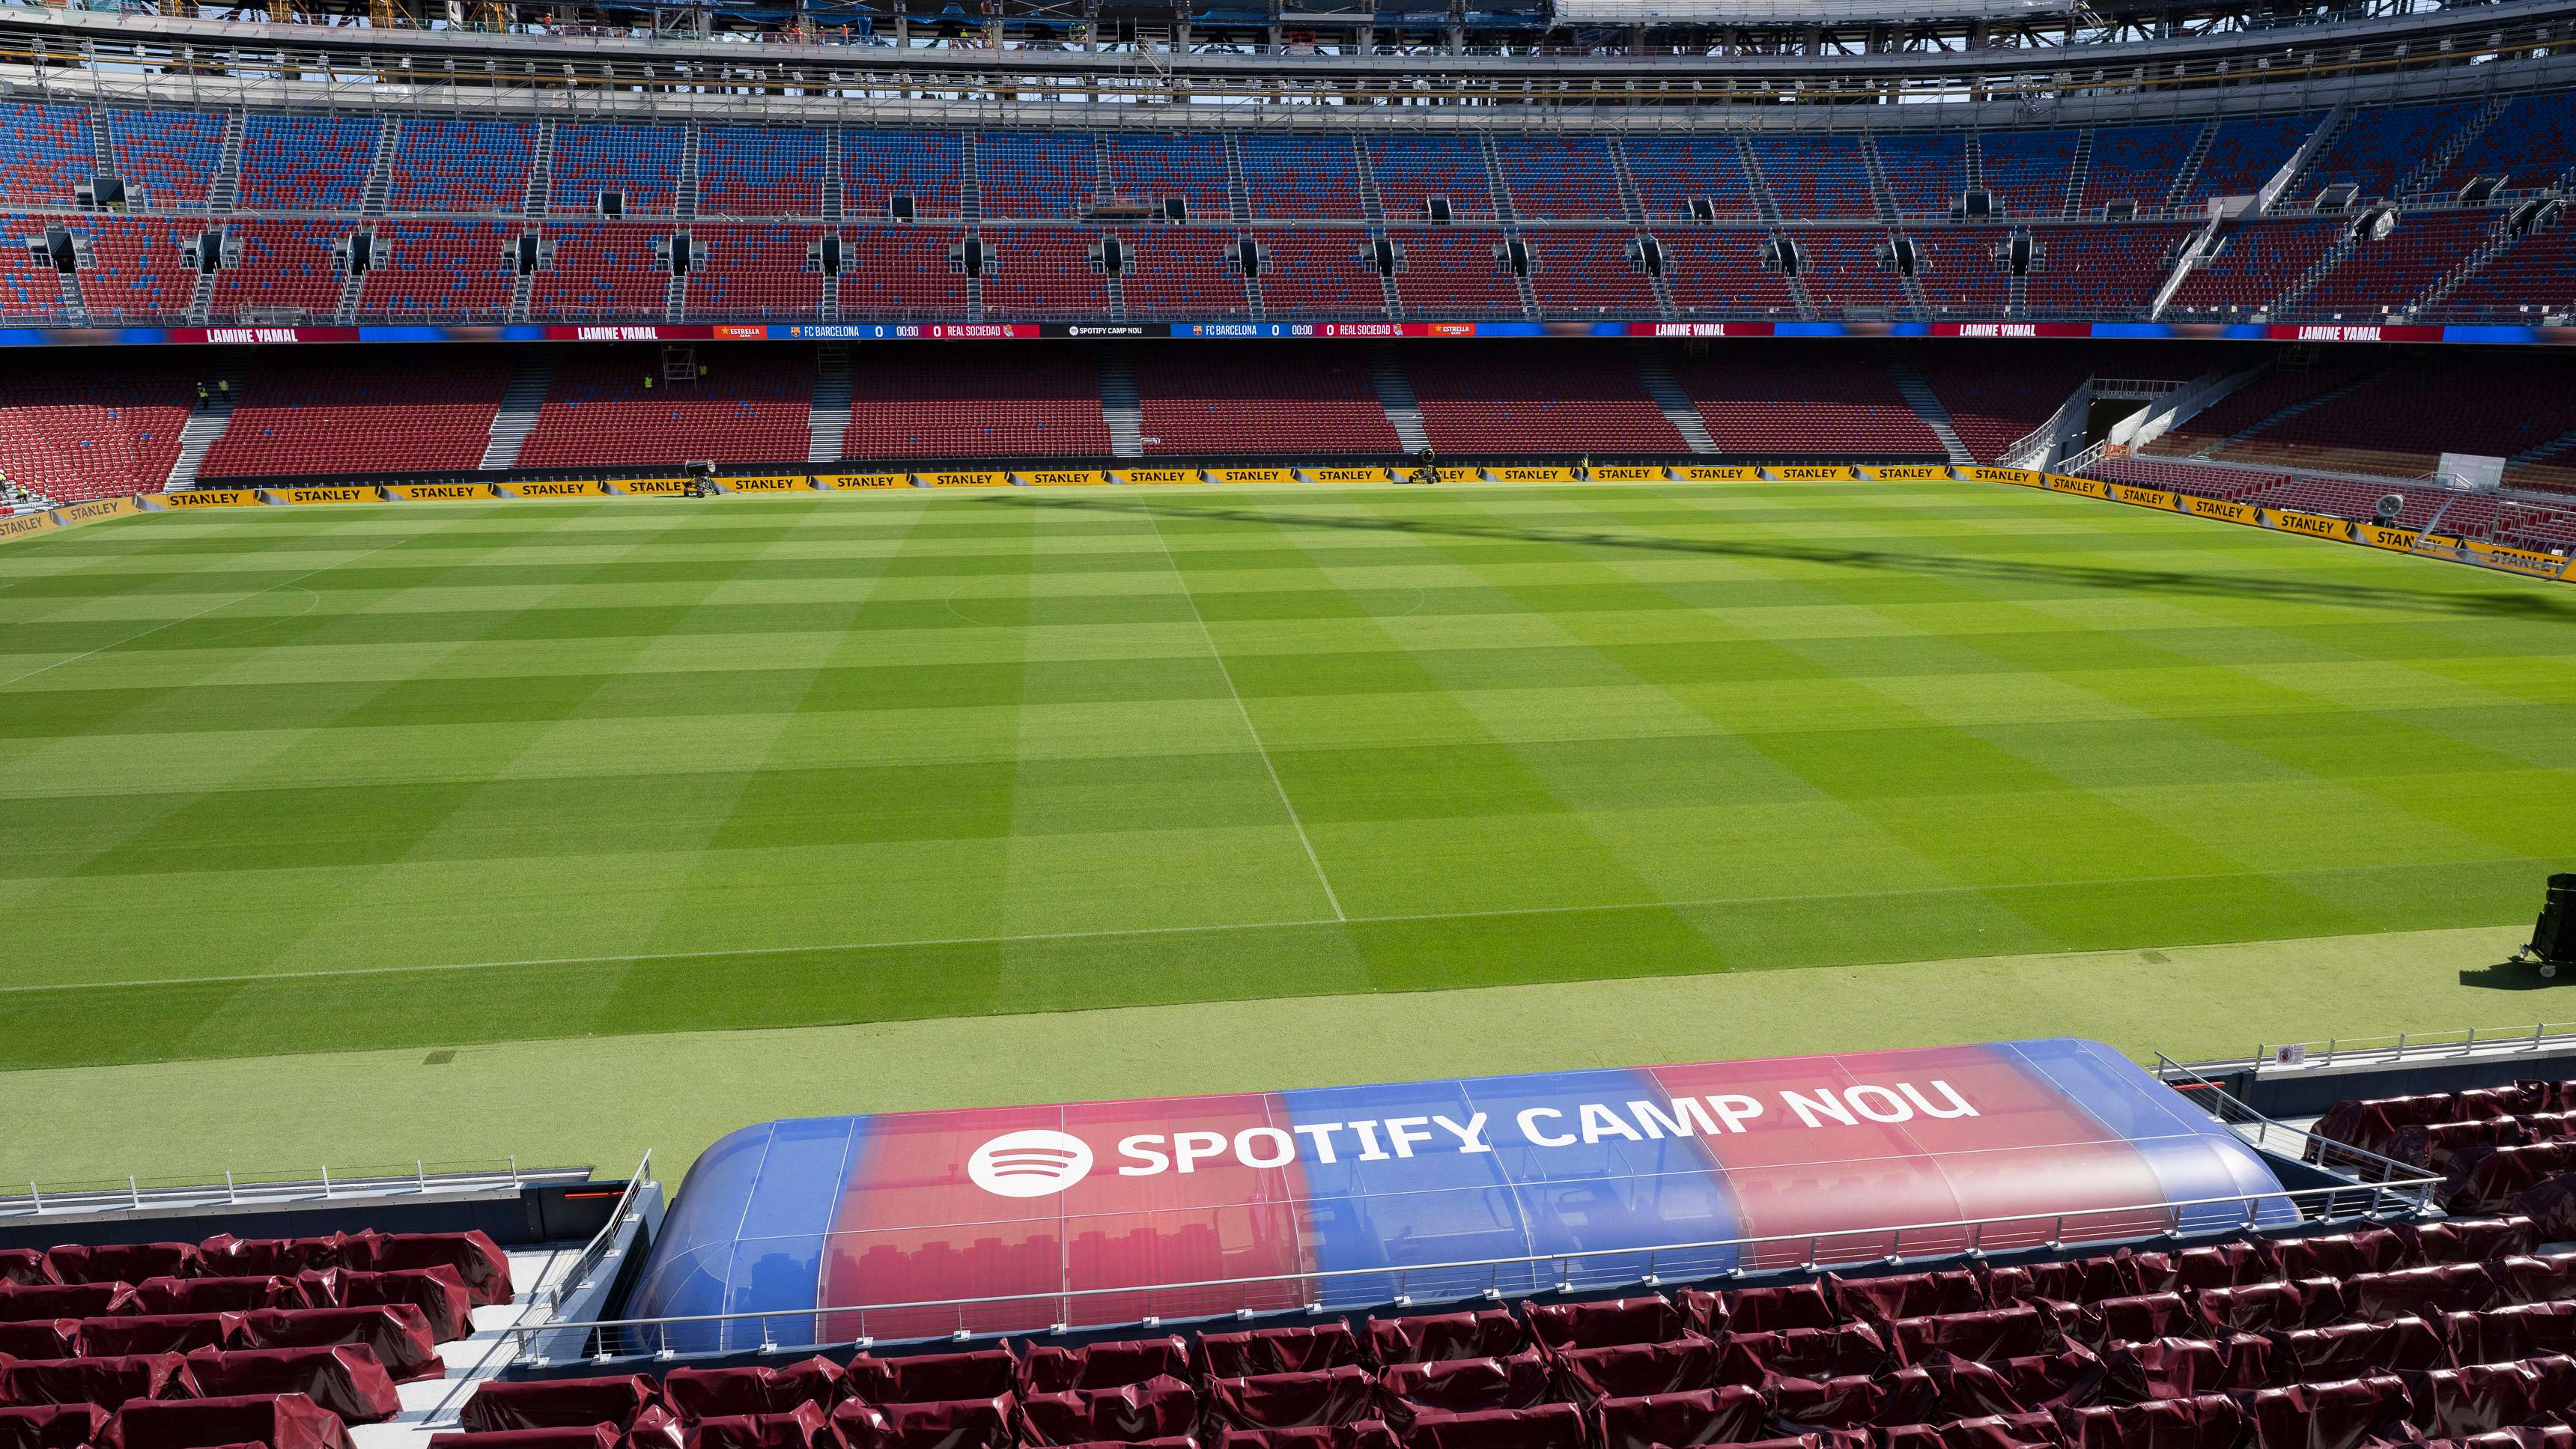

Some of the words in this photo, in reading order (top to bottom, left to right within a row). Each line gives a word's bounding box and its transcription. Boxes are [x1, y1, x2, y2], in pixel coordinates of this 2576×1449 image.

[577, 327, 619, 340] LAMINE
[620, 327, 658, 340] YAMAL
[804, 326, 814, 337] FC
[815, 326, 859, 337] BARCELONA
[875, 326, 884, 337] 0
[896, 326, 919, 336] 00:00
[933, 326, 941, 337] 0
[947, 326, 965, 336] REAL
[966, 326, 1000, 336] SOCIEDAD
[1206, 325, 1215, 335] FC
[1215, 325, 1257, 335] BARCELONA
[1272, 325, 1280, 335] 0
[1292, 325, 1313, 335] 00:00
[1326, 325, 1334, 335] 0
[1340, 325, 1356, 335] REAL
[1357, 325, 1391, 335] SOCIEDAD
[1655, 324, 1691, 336] LAMINE
[1692, 324, 1725, 336] YAMAL
[1959, 324, 1999, 336] LAMINE
[2000, 324, 2036, 336] YAMAL
[2298, 326, 2342, 341] LAMINE
[2343, 326, 2381, 341] YAMAL
[207, 329, 254, 343] LAMINE
[255, 329, 298, 343] YAMAL
[1034, 473, 1090, 483] STANLEY
[1131, 472, 1185, 482] STANLEY
[1226, 470, 1279, 481] STANLEY
[1319, 470, 1373, 480] STANLEY
[1412, 470, 1465, 479] SLEY
[1505, 470, 1558, 479] STANLEY
[1599, 470, 1650, 479] STANLEY
[1690, 469, 1743, 479] STANLEY
[1784, 469, 1837, 479] STANLEY
[1880, 469, 1932, 478] STANLEY
[1975, 469, 2029, 482] STANLEY
[735, 478, 792, 489] STANLEY
[837, 477, 894, 487] STANLEY
[937, 475, 993, 484] STANLEY
[523, 484, 584, 495] STANLEY
[2053, 478, 2095, 493] STANLEY
[294, 490, 361, 501] STANLEY
[411, 487, 474, 498] STANLEY
[2124, 489, 2164, 505] STANLEY
[169, 493, 240, 505] STANLEY
[71, 502, 118, 520] STANLEY
[2196, 501, 2244, 519] STANLEY
[2281, 515, 2334, 535] STANLEY
[2377, 531, 2442, 552] STANEY
[1118, 1112, 1492, 1176] SPOTIFY
[1516, 1093, 1765, 1147] CAMP
[1779, 1079, 1981, 1128] NOU
